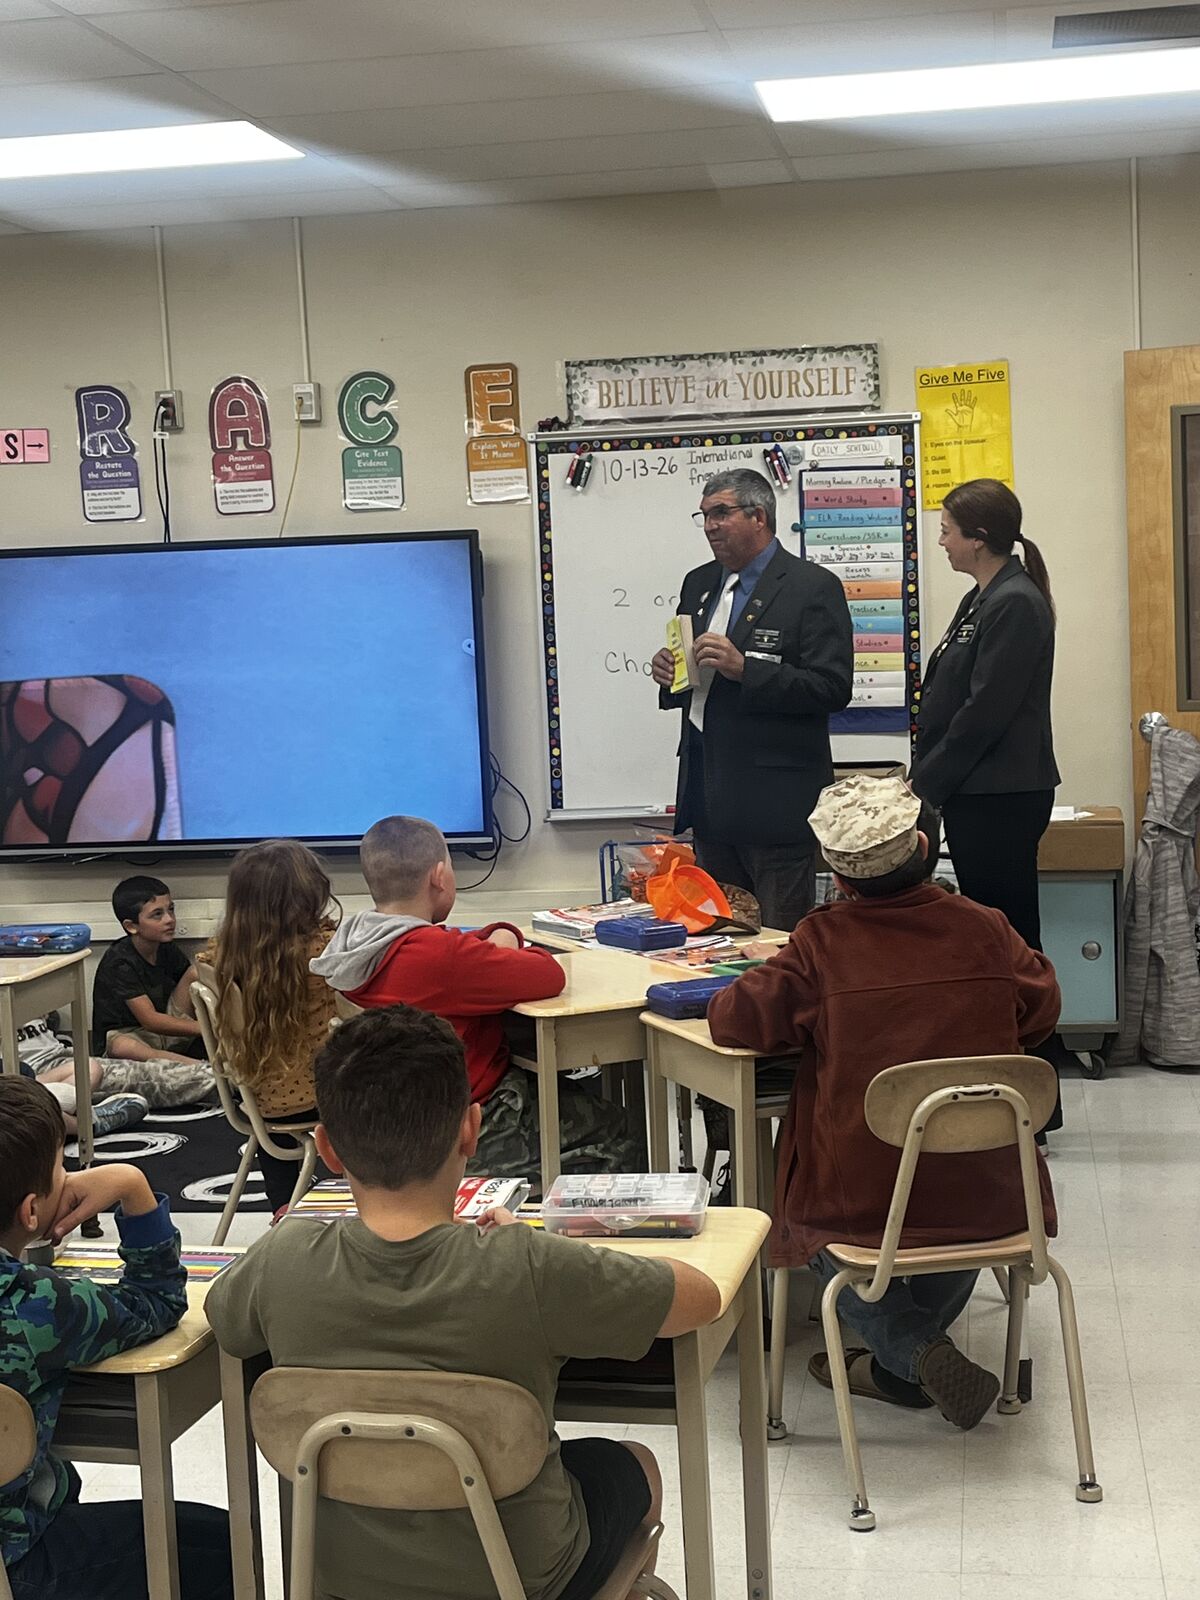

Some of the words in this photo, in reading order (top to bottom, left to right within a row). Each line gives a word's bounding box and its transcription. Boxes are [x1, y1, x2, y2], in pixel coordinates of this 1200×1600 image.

[919, 373, 949, 386] Give
[953, 371, 974, 383] Me
[977, 369, 1005, 381] Five
[597, 375, 697, 410] BELIEVE
[705, 378, 730, 400] in
[736, 366, 858, 401] YOURSELF
[76, 385, 136, 459] R
[209, 376, 271, 453] A
[338, 371, 399, 446] C
[464, 362, 520, 438] E
[472, 442, 498, 451] Explain
[500, 440, 520, 449] What
[354, 450, 370, 458] Cite
[373, 449, 389, 457] Text
[816, 446, 838, 455] DAILY
[228, 454, 255, 462] Answer
[95, 461, 122, 470] Restate
[220, 464, 233, 472] the
[235, 463, 265, 471] Question
[357, 459, 388, 467] Evidence
[87, 471, 99, 479] the
[102, 470, 132, 478] Question
[602, 455, 678, 485] 10-13-26
[861, 477, 887, 487] Pledge
[823, 495, 842, 503] Word
[817, 513, 831, 522] ELA
[612, 588, 630, 608] 2
